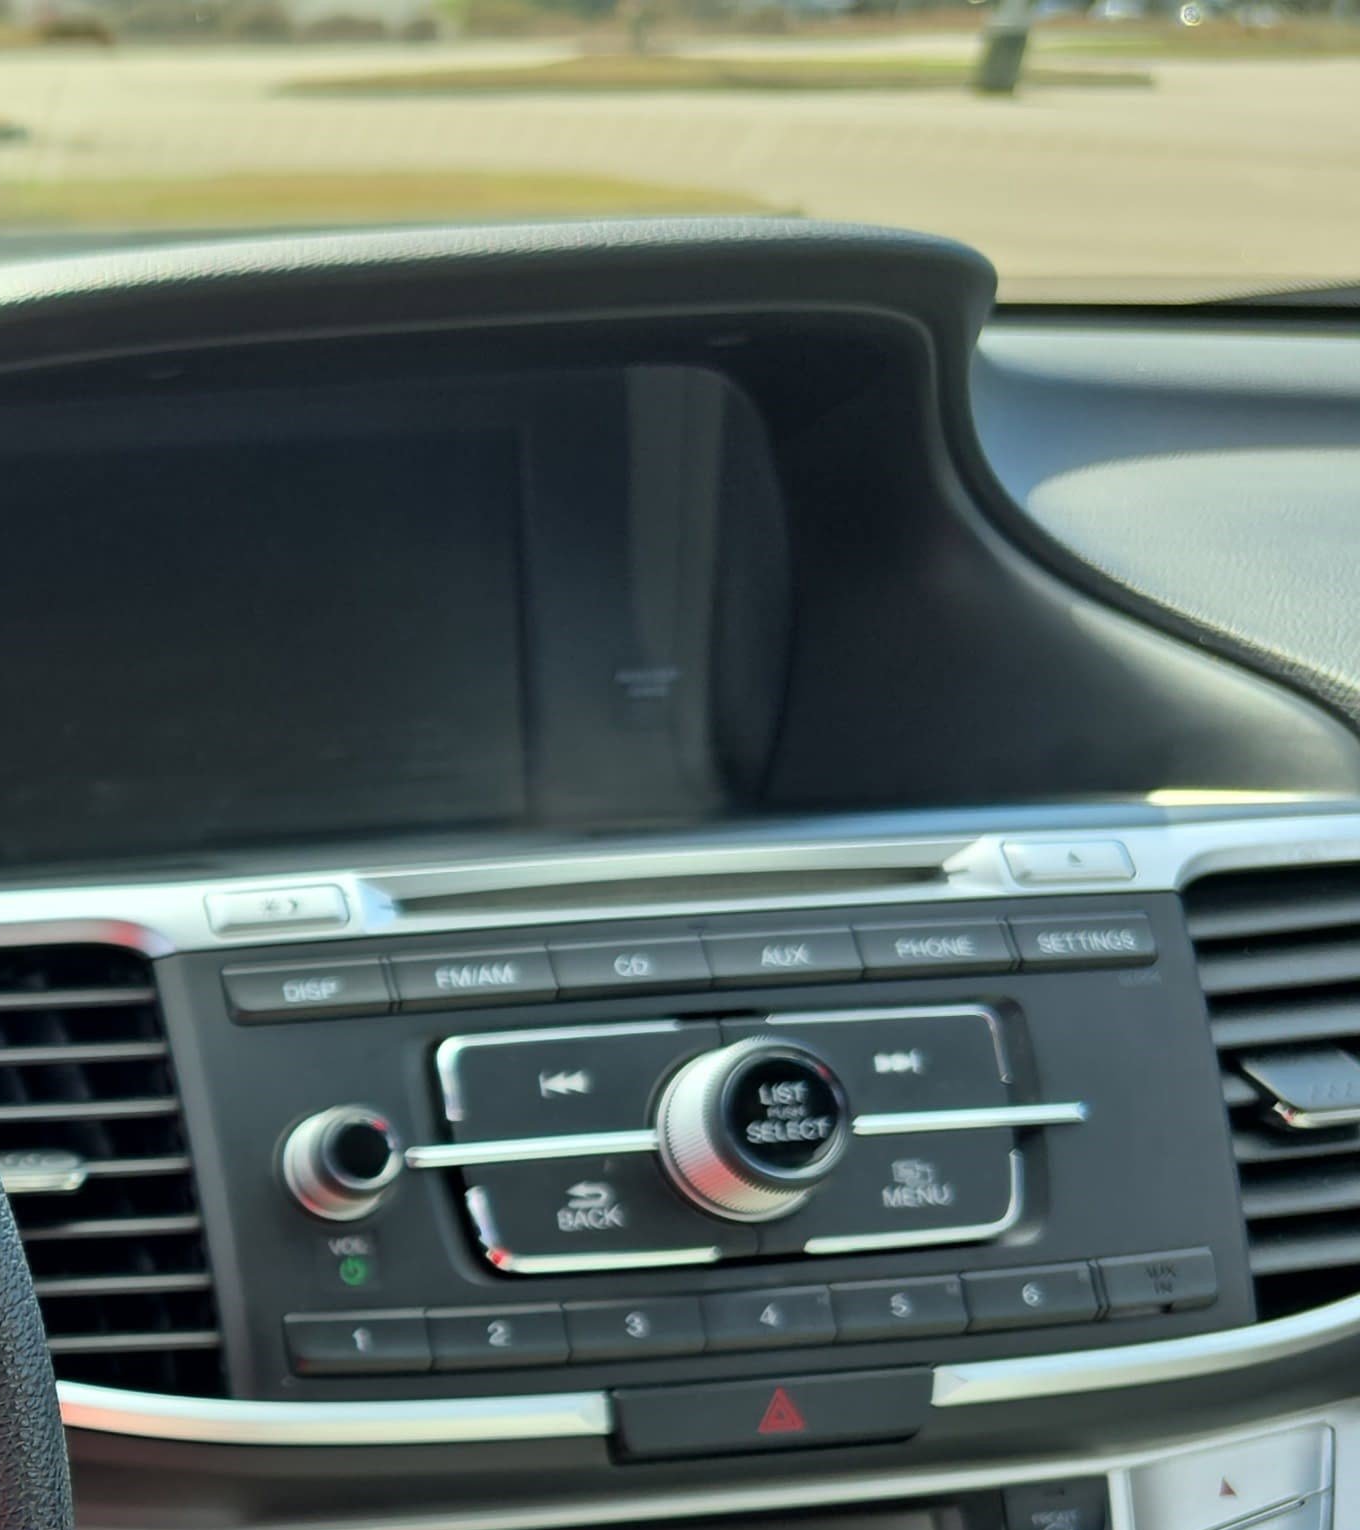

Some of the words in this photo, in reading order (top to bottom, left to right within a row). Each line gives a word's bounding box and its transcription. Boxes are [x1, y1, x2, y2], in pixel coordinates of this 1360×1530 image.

[894, 934, 976, 959] PHONE
[1035, 928, 1137, 954] SETTINGS
[613, 952, 649, 978] CD
[760, 942, 810, 968] AUX
[435, 963, 517, 990] FM/AM
[282, 979, 341, 1003] DISP
[758, 1080, 809, 1107] LIST
[745, 1116, 830, 1145] SELECT
[882, 1184, 954, 1209] MENU
[556, 1207, 624, 1232] BACK
[327, 1237, 370, 1257] VOL
[890, 1293, 913, 1318] 5
[1021, 1281, 1045, 1307] 6
[624, 1311, 650, 1339] 3
[759, 1302, 779, 1328] 4
[352, 1327, 373, 1353] 1
[487, 1319, 512, 1347] 2
